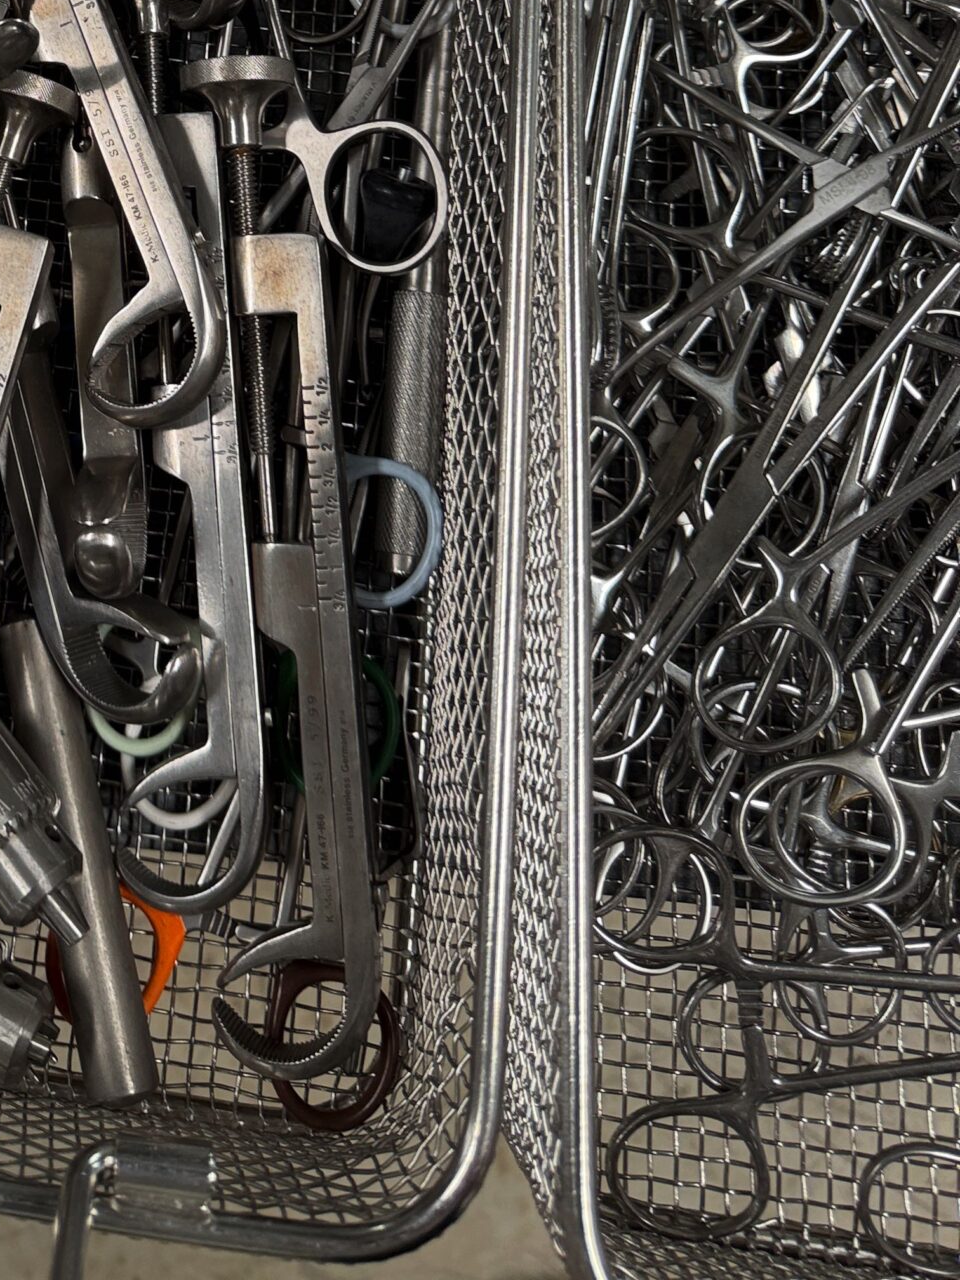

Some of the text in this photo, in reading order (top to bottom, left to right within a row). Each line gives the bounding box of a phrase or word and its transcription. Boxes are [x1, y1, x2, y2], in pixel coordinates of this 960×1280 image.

[119, 102, 137, 141] Germany
[100, 128, 120, 158] SSI
[130, 206, 143, 221] KM
[315, 376, 330, 397] 1/2
[318, 407, 332, 427] 1/4
[321, 442, 334, 452] 2
[322, 466, 338, 488] 3/4
[325, 495, 339, 516] 1/2
[327, 526, 341, 546] 1/4
[332, 589, 347, 613] 3/4
[339, 727, 352, 774] Germany
[322, 853, 330, 870] KM
